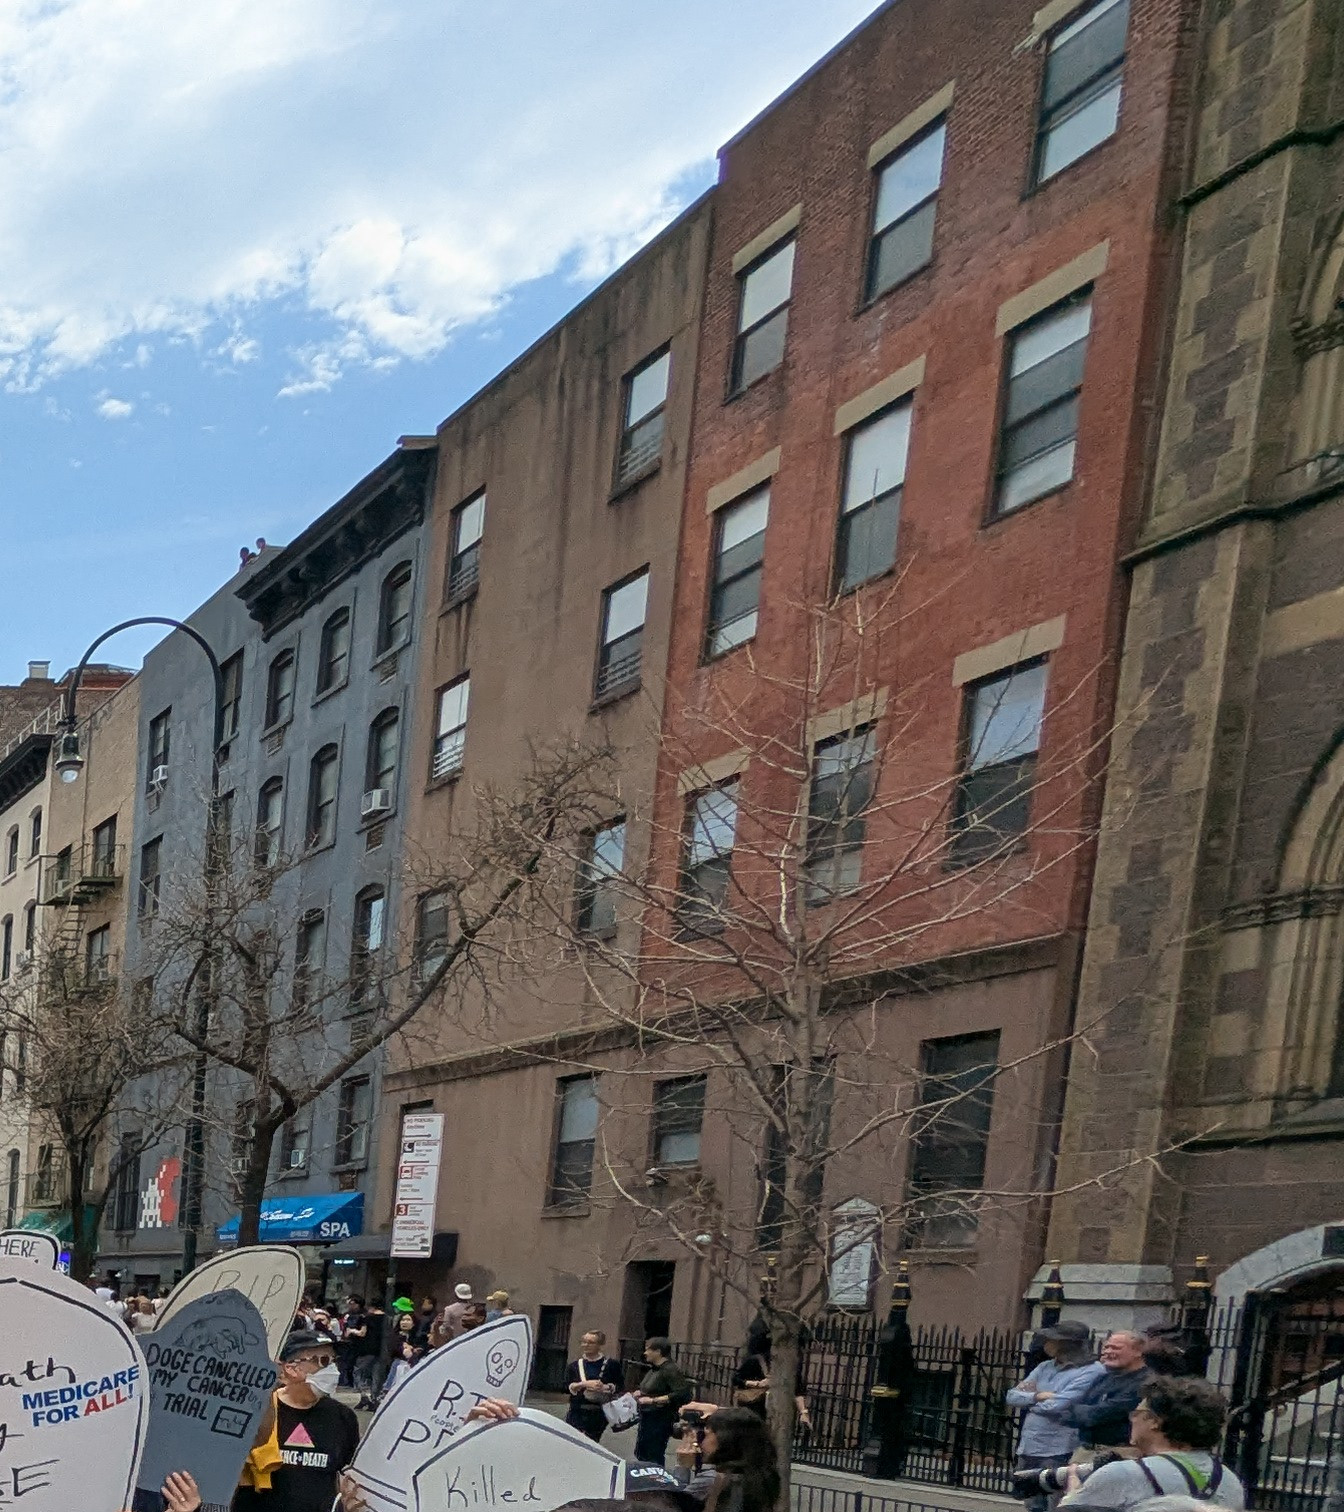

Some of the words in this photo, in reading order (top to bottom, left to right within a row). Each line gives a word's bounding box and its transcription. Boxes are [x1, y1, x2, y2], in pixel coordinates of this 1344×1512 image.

[319, 1221, 350, 1238] SPA
[22, 1365, 140, 1409] MEDICARE
[146, 1343, 191, 1374] DOGE
[193, 1354, 277, 1390] CANCELLED
[152, 1369, 178, 1388] MY
[187, 1376, 250, 1405] CANCER
[32, 1405, 80, 1427] FOR
[83, 1383, 134, 1416] ALL!
[164, 1393, 208, 1420] TRIAL
[445, 1464, 541, 1508] Killed
